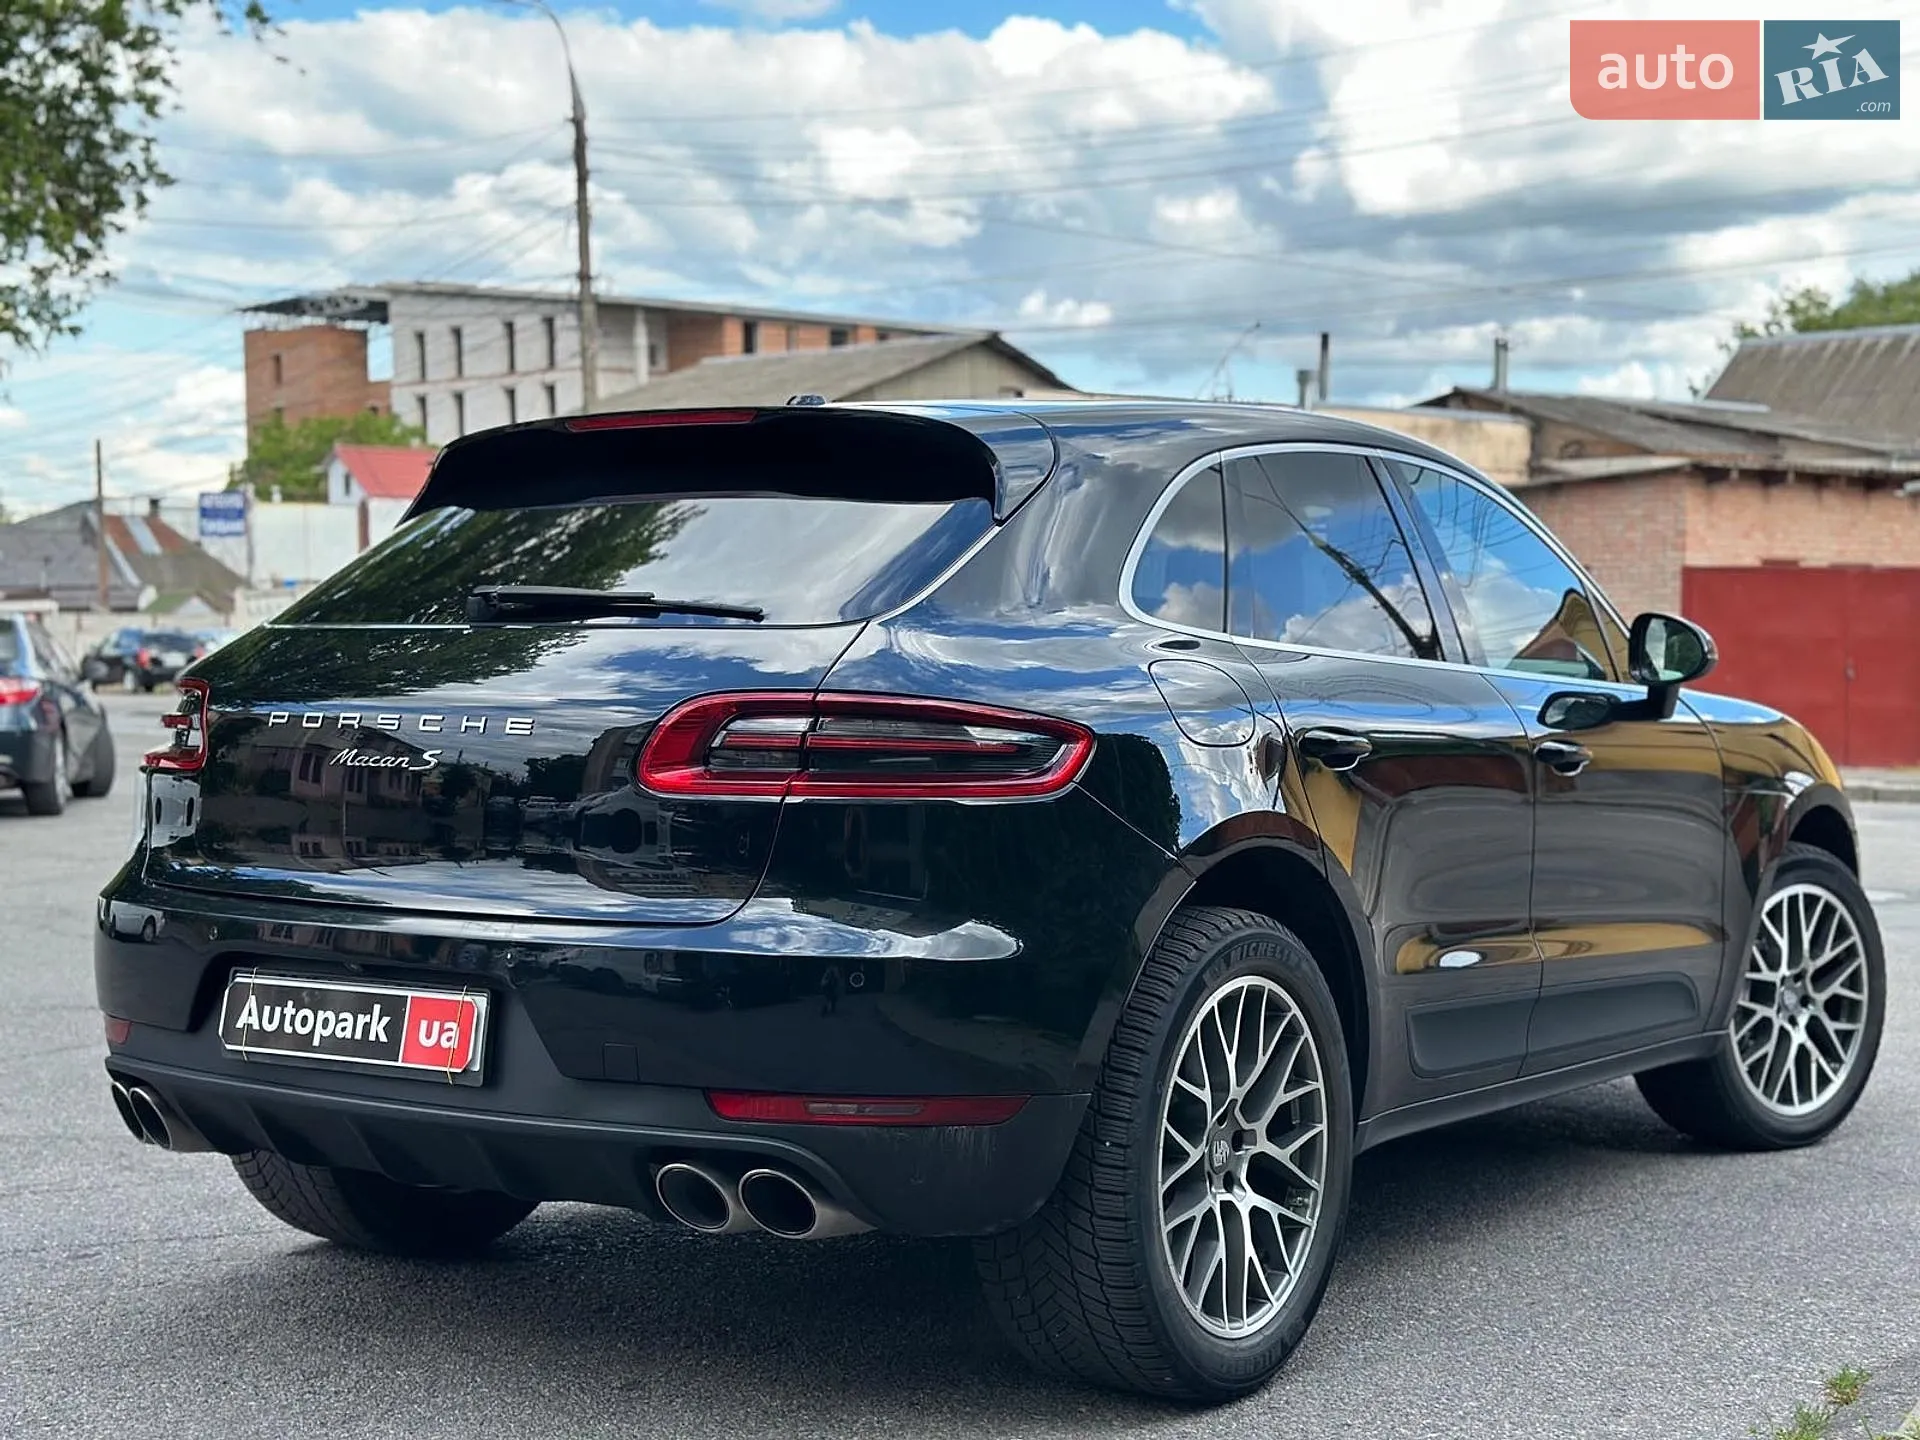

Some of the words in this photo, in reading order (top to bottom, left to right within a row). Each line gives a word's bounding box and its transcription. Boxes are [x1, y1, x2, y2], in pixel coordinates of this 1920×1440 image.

[268, 711, 535, 736] PORSCHE
[329, 748, 411, 769] Macan
[408, 749, 442, 771] S
[235, 994, 392, 1047] Autopark
[418, 1019, 460, 1049] ua
